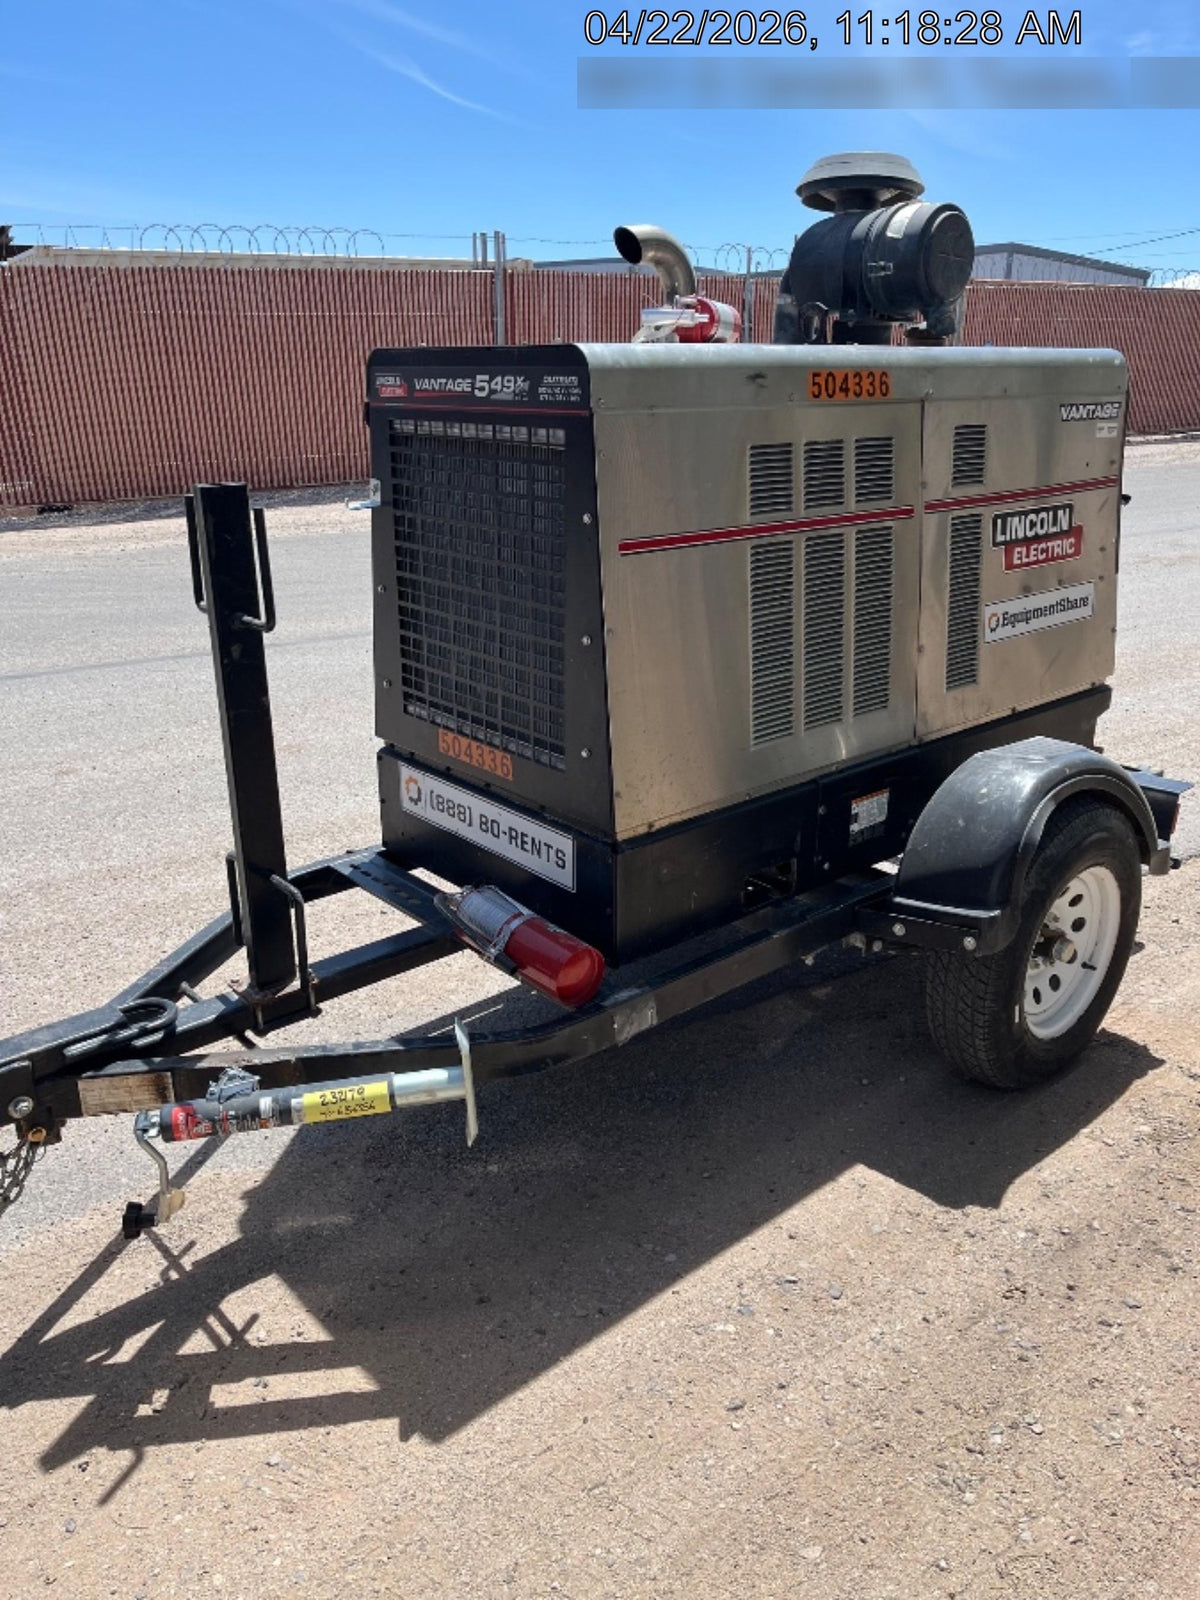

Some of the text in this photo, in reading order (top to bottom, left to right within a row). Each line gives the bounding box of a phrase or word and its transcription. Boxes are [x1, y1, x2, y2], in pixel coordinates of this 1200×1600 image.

[414, 378, 472, 392] VANTAGE
[812, 371, 889, 398] 504336
[1061, 403, 1119, 420] VANTAGE
[995, 508, 1070, 543] LINCOLN
[1013, 537, 1075, 565] ELECTRIC
[1002, 596, 1089, 628] EquipmentShare
[441, 732, 511, 778] 504336
[429, 789, 473, 827] (888)
